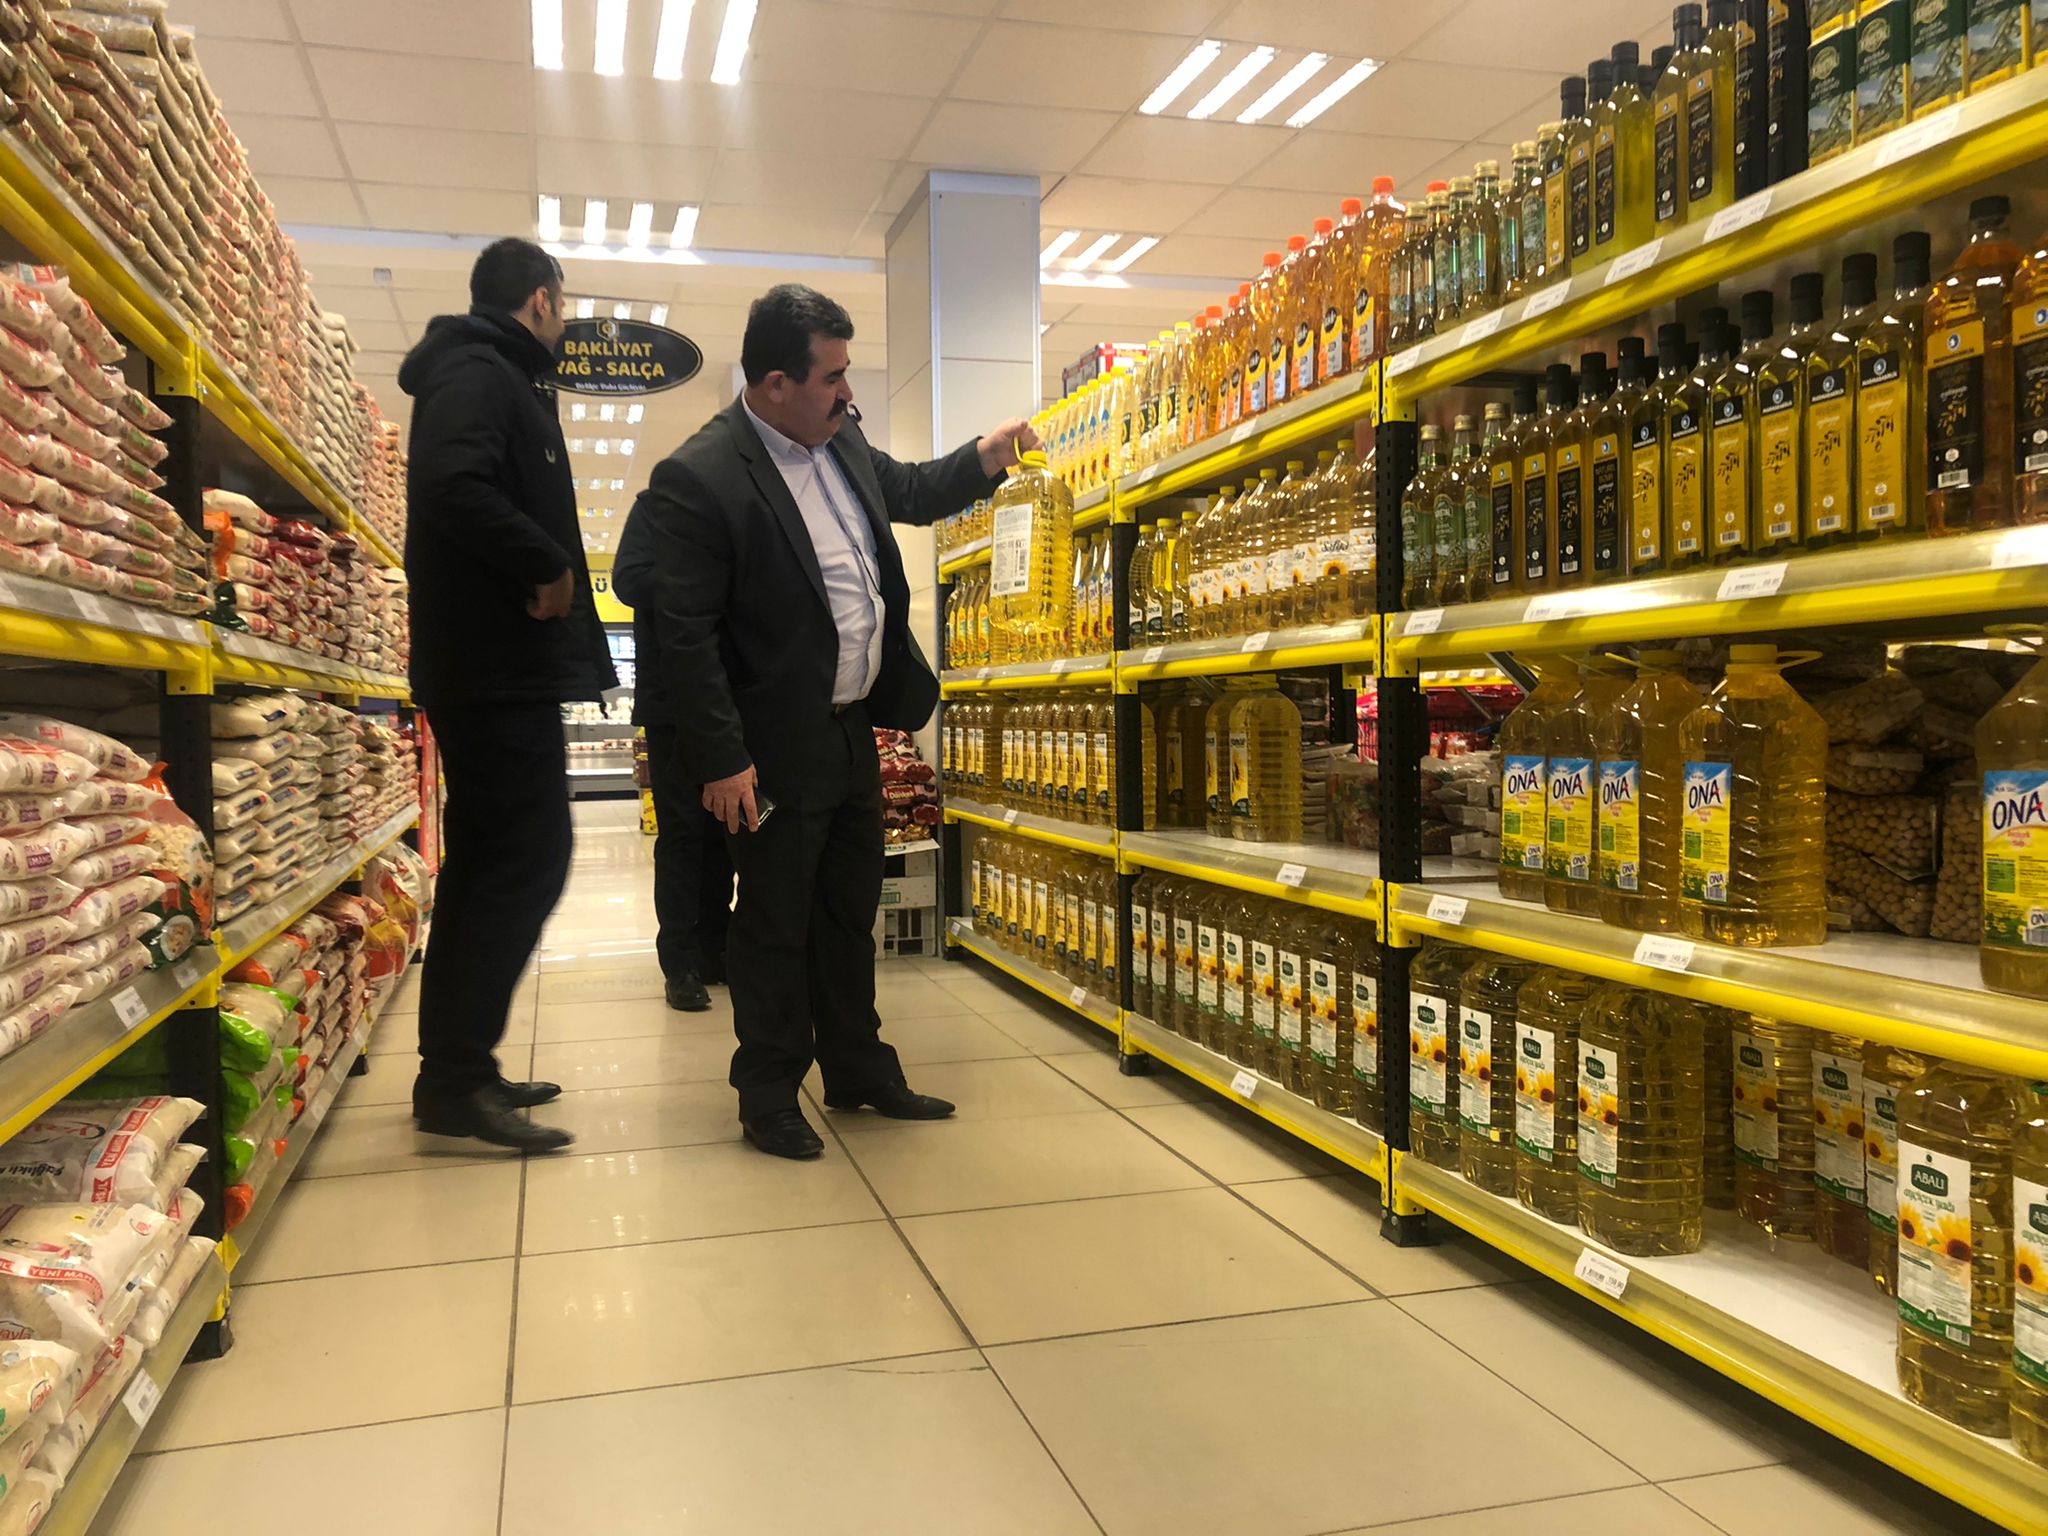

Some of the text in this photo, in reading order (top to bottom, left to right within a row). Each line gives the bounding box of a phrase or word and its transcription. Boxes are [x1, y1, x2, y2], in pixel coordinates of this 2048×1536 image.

[564, 338, 654, 357] BAKLİYAT
[606, 362, 665, 381] SALÇA
[1508, 769, 1540, 795] ONA
[1552, 773, 1585, 800] ONA
[1602, 776, 1632, 805] ONA
[1688, 779, 1723, 810] ONA
[1992, 791, 2047, 831] ONA
[1913, 1169, 1945, 1190] ABALI
[31, 1267, 61, 1277] YENİ
